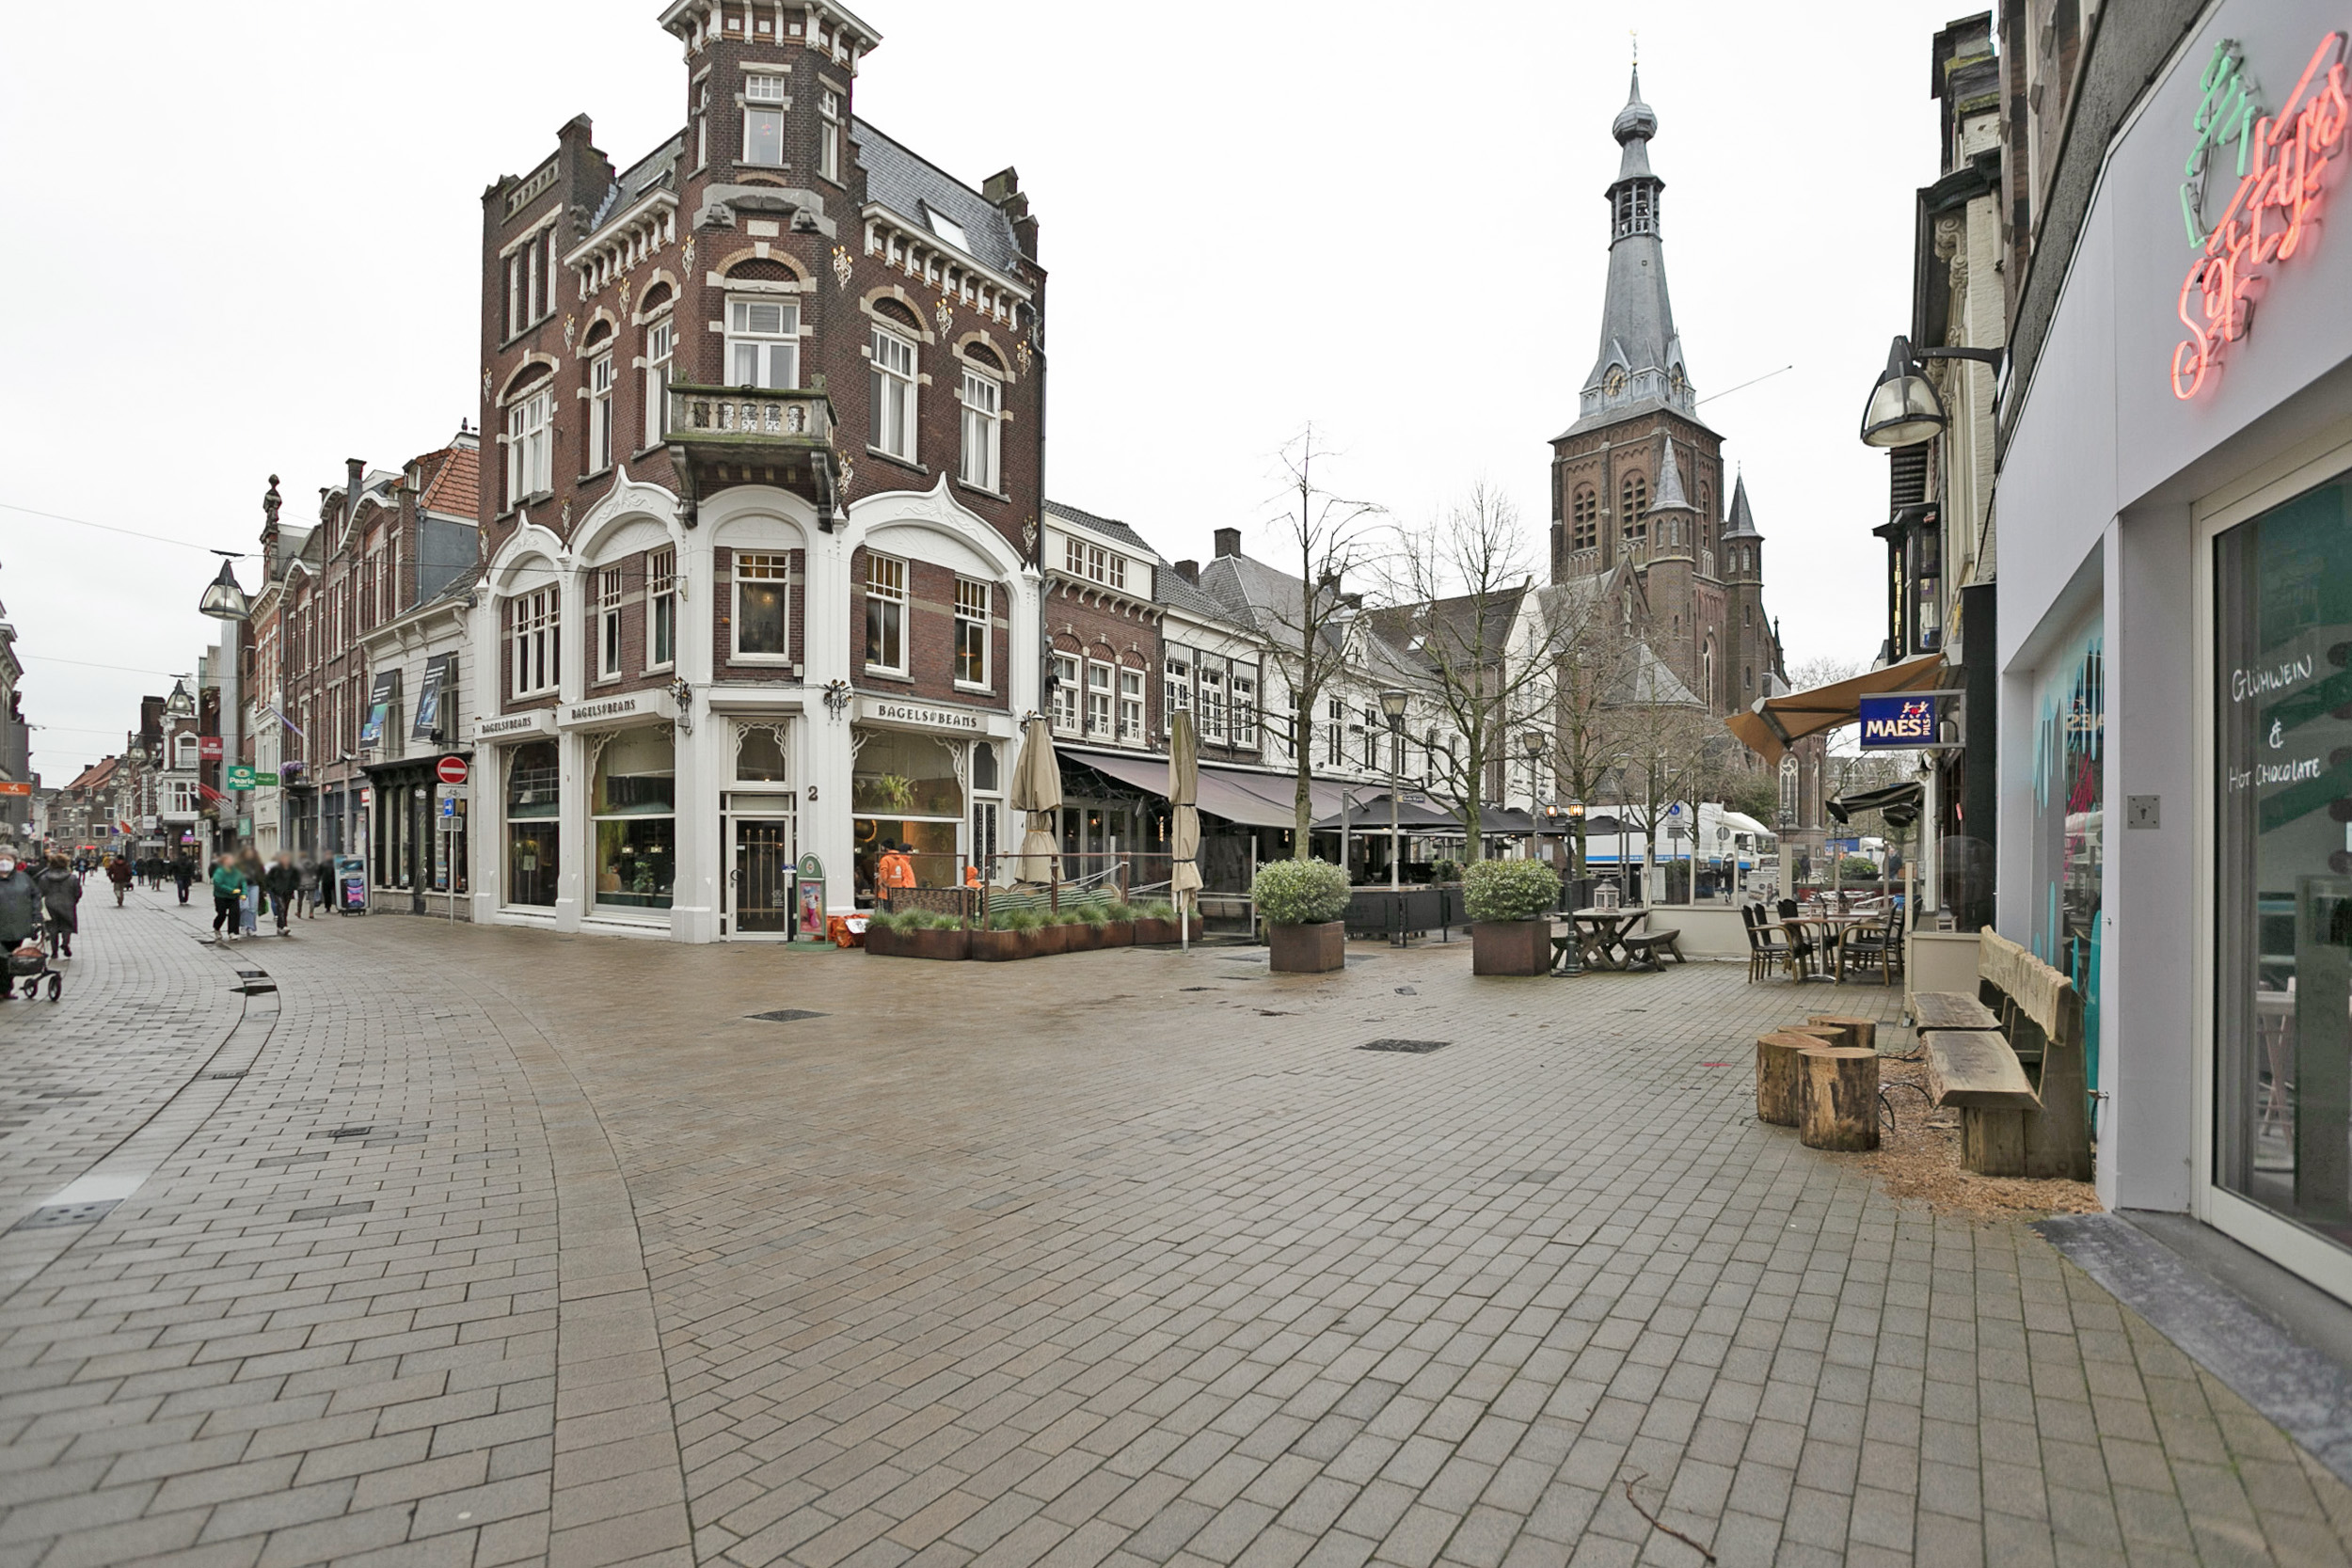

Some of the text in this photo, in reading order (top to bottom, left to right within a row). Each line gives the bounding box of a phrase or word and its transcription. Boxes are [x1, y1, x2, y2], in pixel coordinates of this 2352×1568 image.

[571, 699, 635, 720] BAGELS BEANS
[879, 705, 977, 727] BAGELS BEANS
[481, 716, 532, 734] BAGELS BEANS
[1865, 719, 1922, 738] MAES
[1922, 718, 1931, 736] PILS
[2269, 718, 2283, 749] &
[2228, 757, 2321, 793] HOT CHOCOLATE
[807, 785, 818, 801] 2
